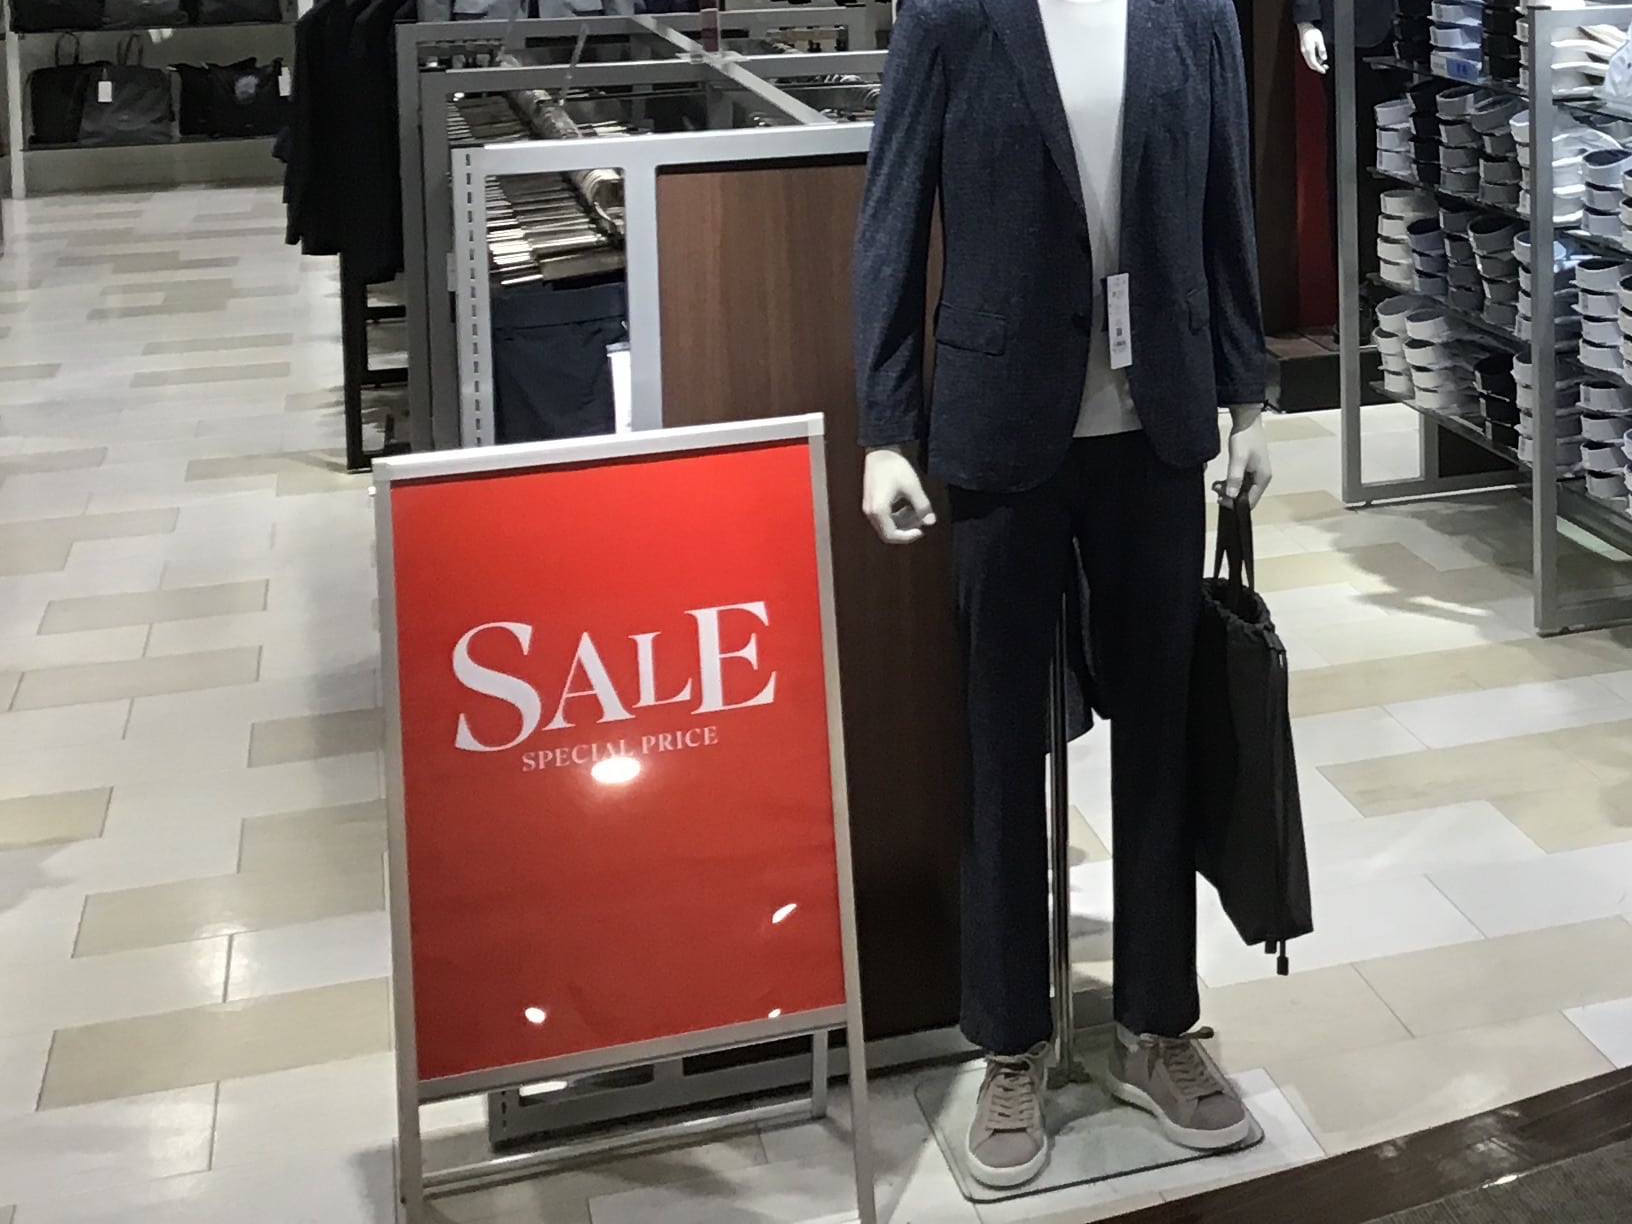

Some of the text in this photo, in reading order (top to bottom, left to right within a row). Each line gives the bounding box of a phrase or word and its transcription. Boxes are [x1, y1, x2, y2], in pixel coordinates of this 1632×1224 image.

[452, 601, 776, 752] SALE
[522, 726, 719, 772] SPECIAL PRICE
